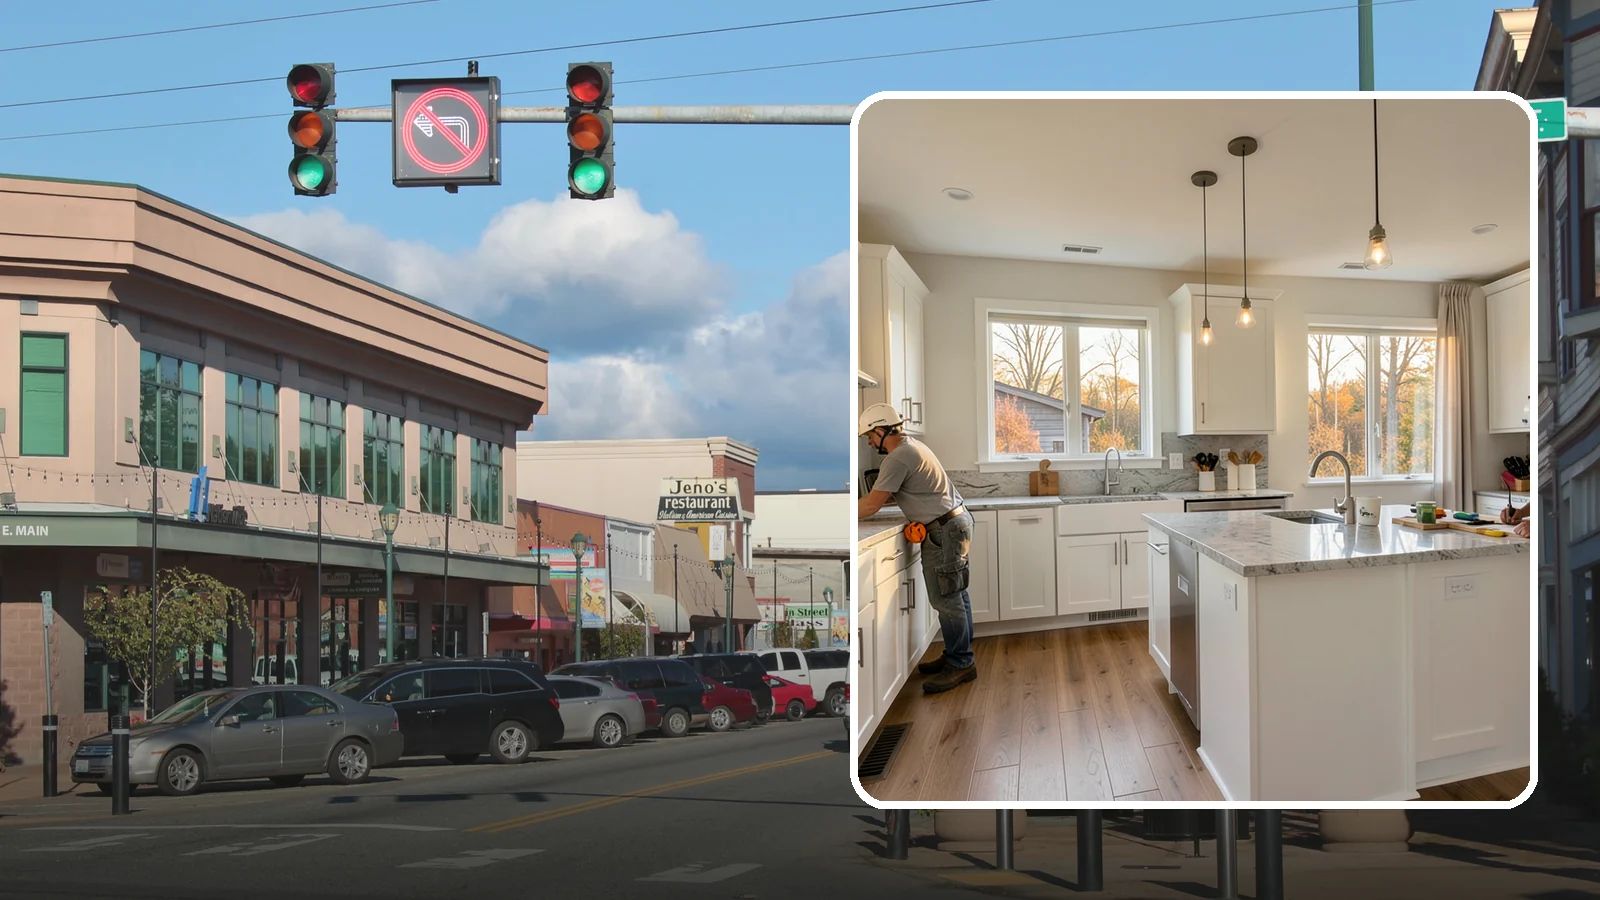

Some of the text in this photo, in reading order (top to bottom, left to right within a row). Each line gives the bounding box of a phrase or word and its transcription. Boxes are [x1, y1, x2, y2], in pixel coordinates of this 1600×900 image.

[669, 480, 728, 494] Jeno's
[665, 496, 731, 509] restaurant
[659, 511, 681, 519] Italian
[686, 510, 715, 519] American
[715, 510, 738, 519] Cuisine
[2, 525, 49, 536] E. MAIN
[797, 607, 828, 617] Street
